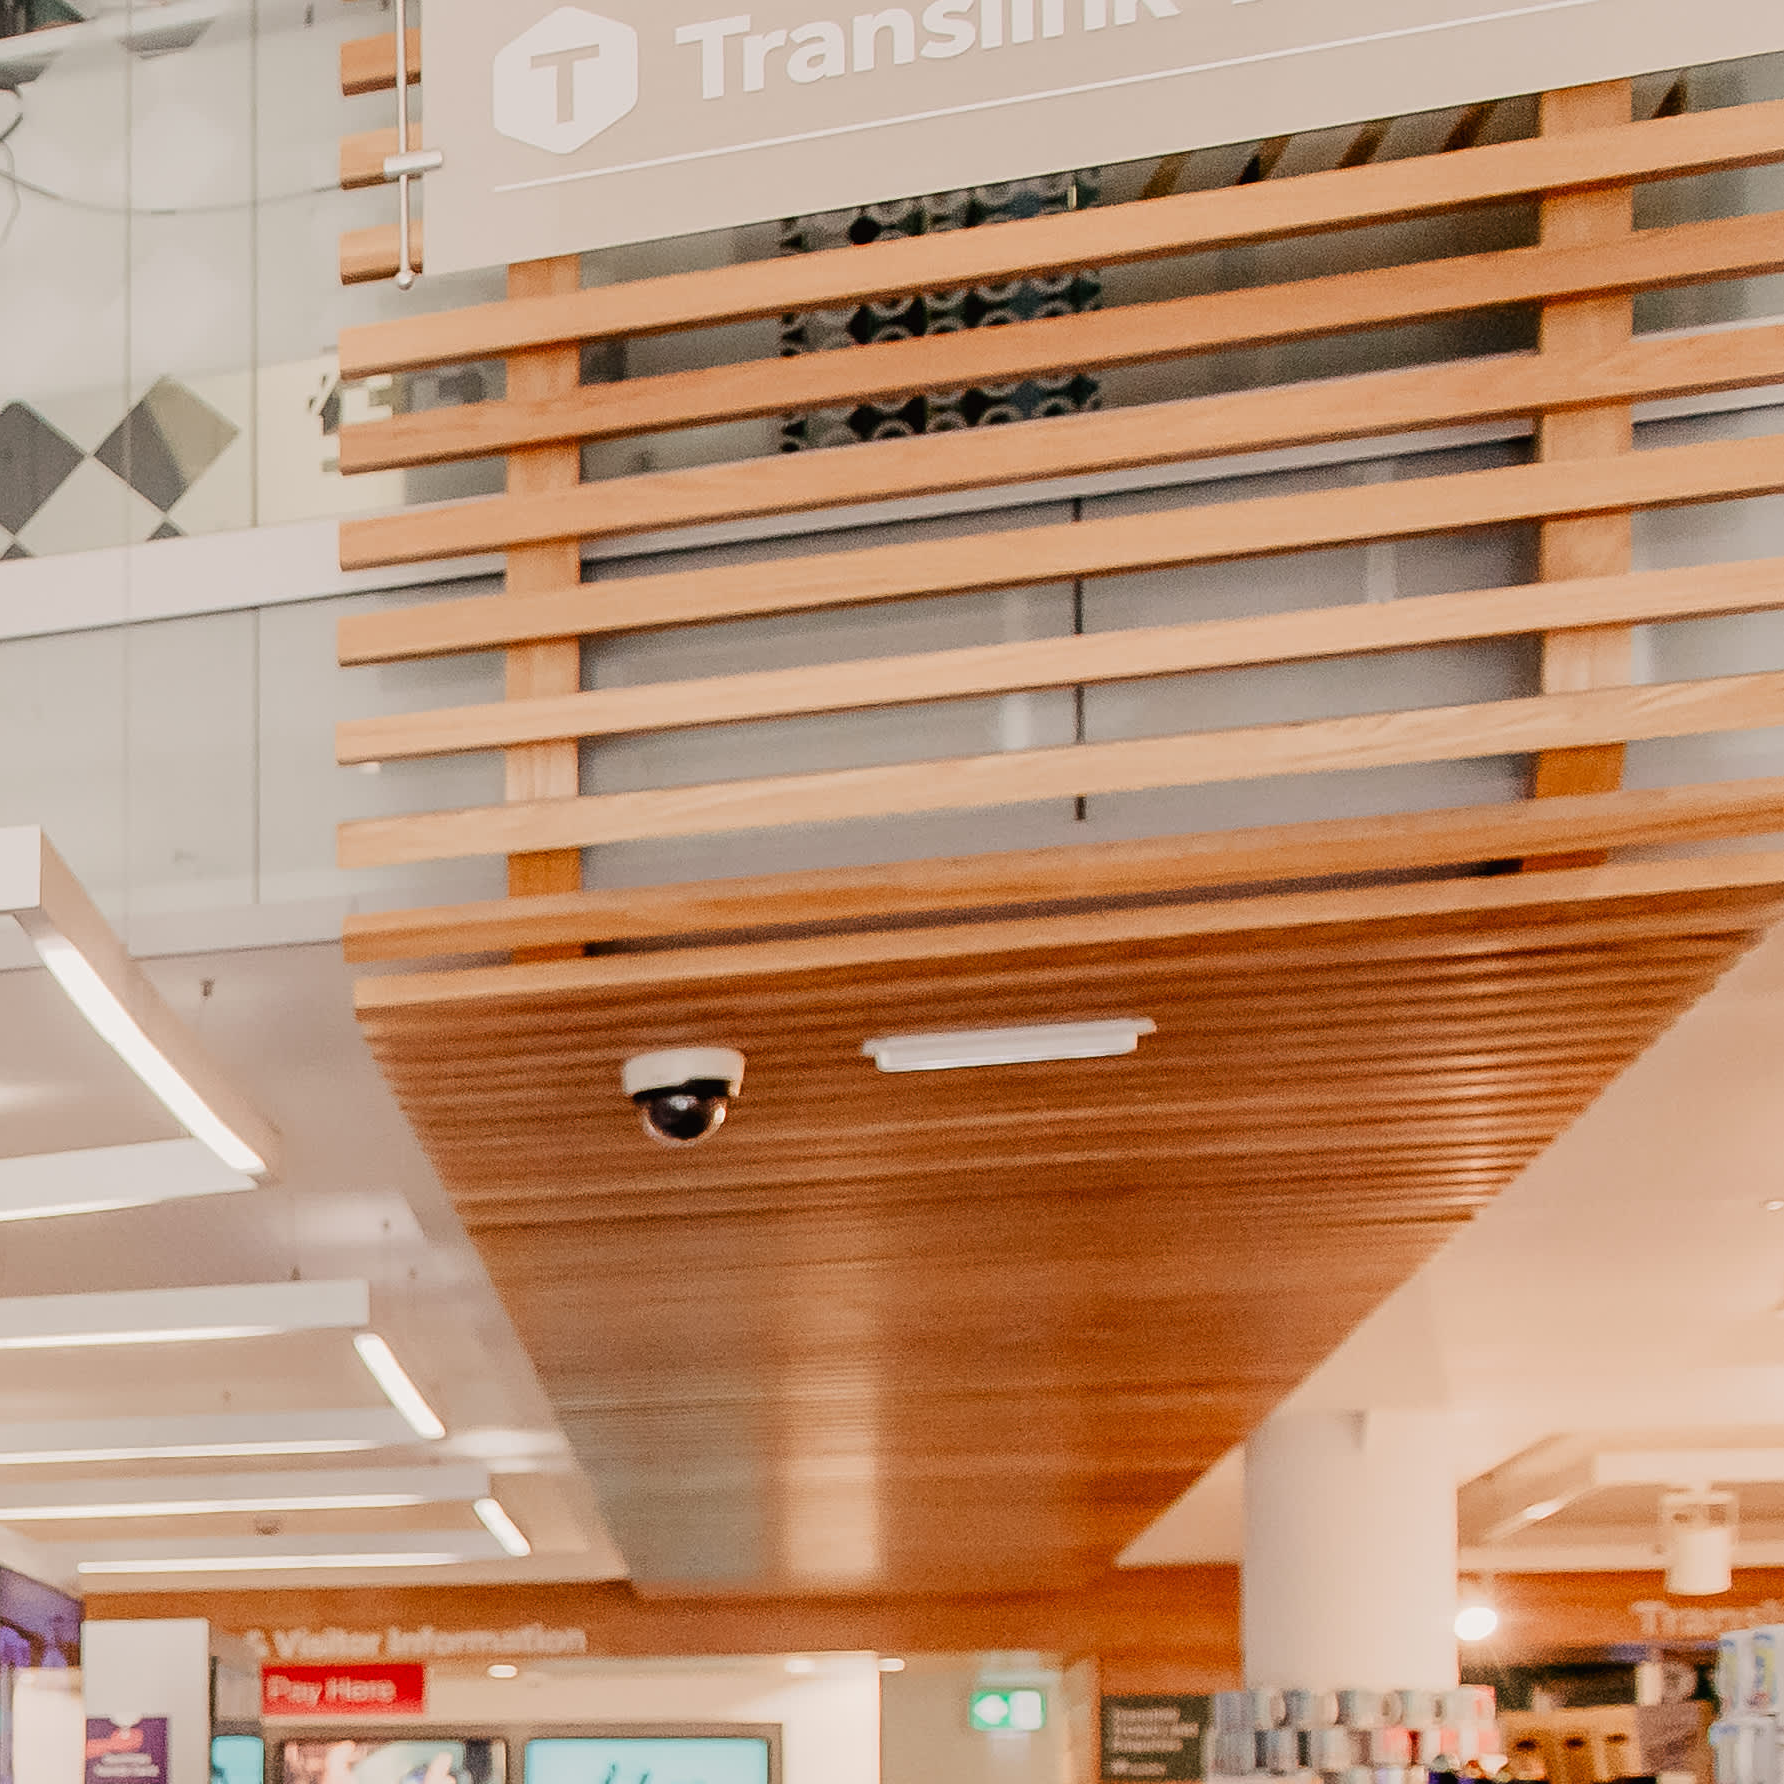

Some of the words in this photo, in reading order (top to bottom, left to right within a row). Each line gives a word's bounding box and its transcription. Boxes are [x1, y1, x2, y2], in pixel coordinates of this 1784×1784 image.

[274, 1627, 381, 1657] Visitor
[267, 1675, 324, 1707] Pay
[326, 1677, 397, 1703] Here
